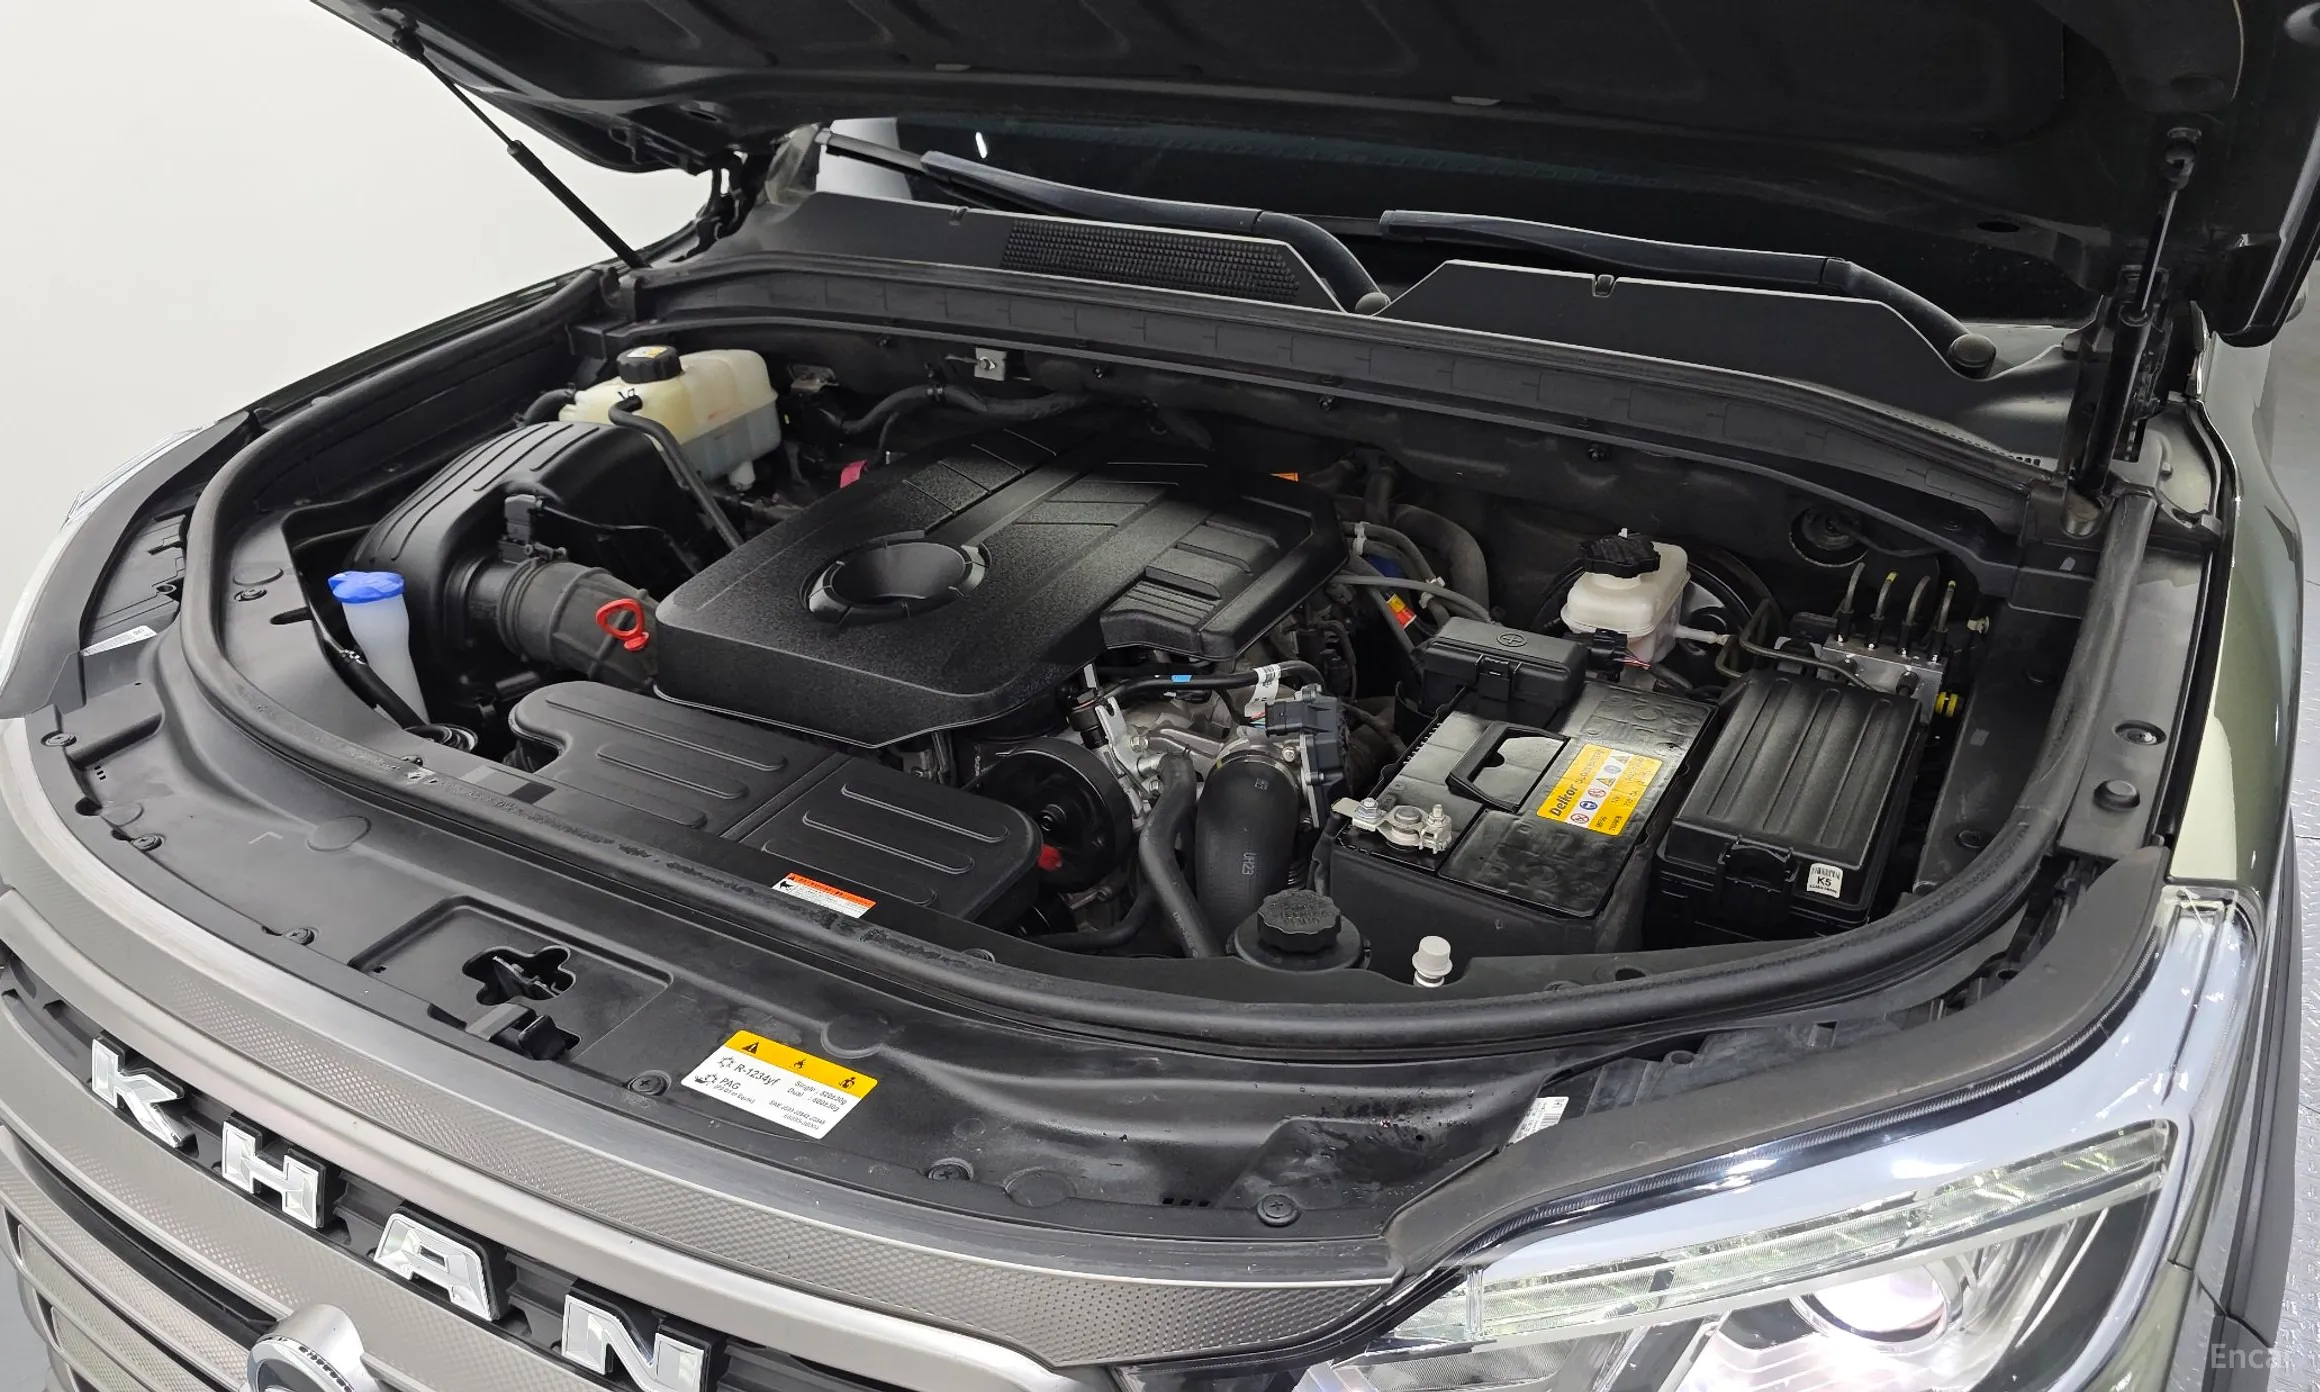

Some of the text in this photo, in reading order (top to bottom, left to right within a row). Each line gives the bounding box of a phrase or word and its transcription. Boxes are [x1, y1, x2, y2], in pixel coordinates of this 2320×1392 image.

[1548, 783, 1579, 817] Delkor
[1817, 875, 1832, 887] K5
[719, 1077, 742, 1090] PAG
[733, 1063, 781, 1086] R-1234yf
[786, 1087, 805, 1098] Dual
[92, 1036, 705, 1392] KHAN
